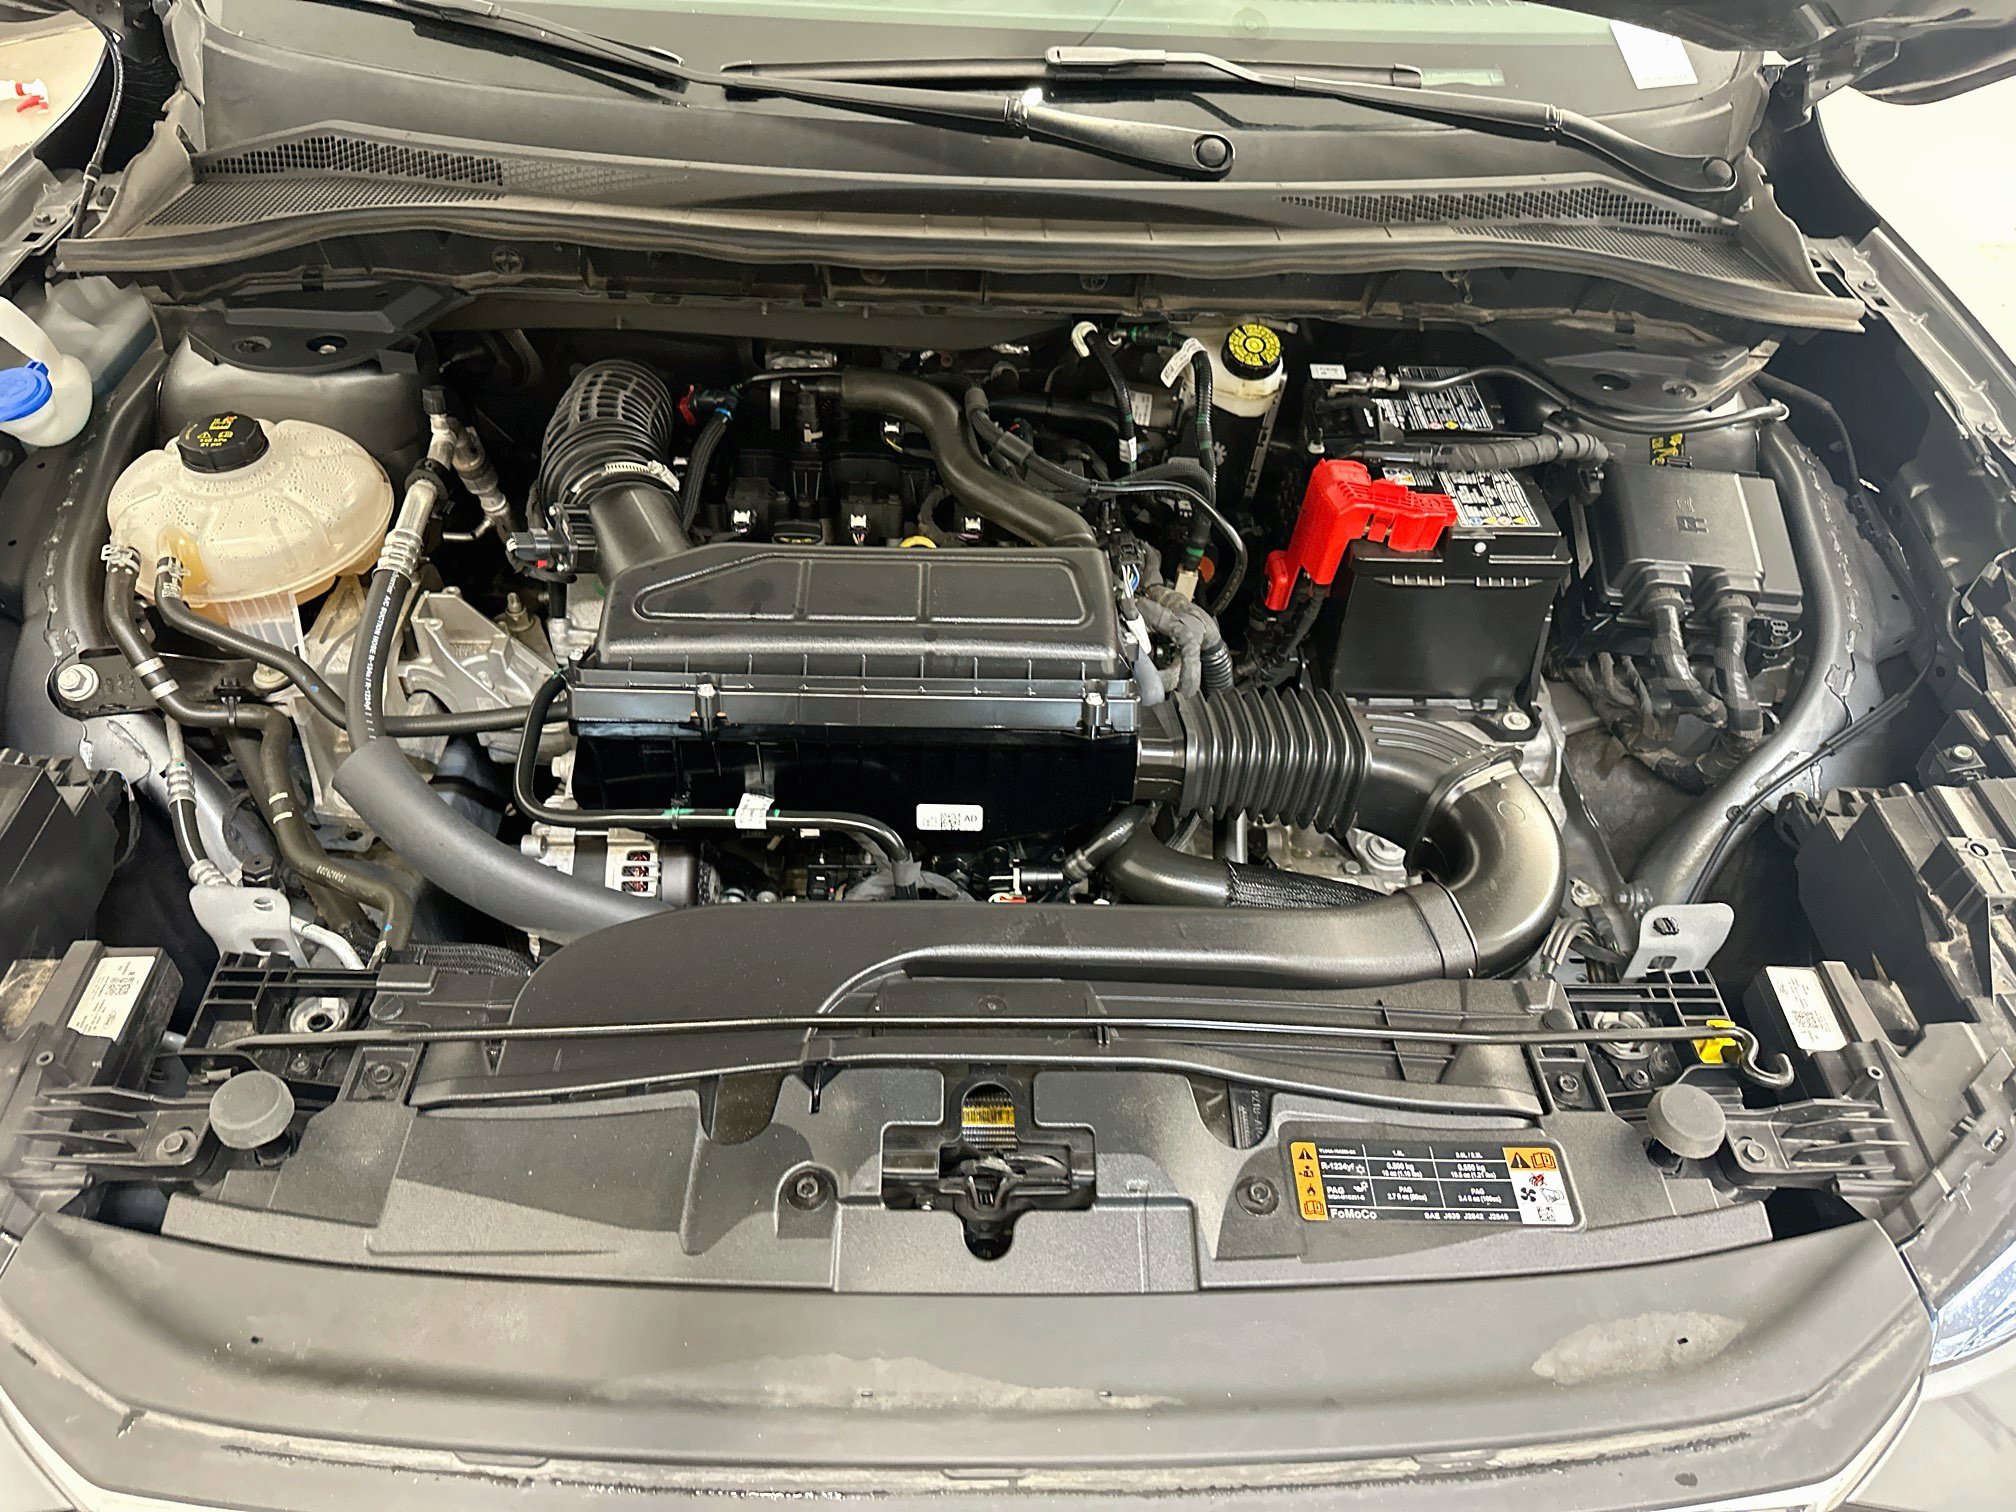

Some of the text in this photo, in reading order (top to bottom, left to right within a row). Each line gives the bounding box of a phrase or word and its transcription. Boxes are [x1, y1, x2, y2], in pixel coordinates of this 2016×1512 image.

[382, 594, 391, 607] A/C
[374, 606, 388, 636] SUCTION
[369, 635, 380, 655] HOSE
[365, 654, 375, 678] R-134a
[364, 681, 372, 711] R-1234yf
[1321, 1161, 1355, 1173] R-1234yf
[1404, 1162, 1415, 1173] kg
[1475, 1163, 1486, 1174] kg
[1326, 1186, 1345, 1195] PAG
[1398, 1185, 1413, 1193] PAG
[1470, 1187, 1485, 1195] PAG
[1330, 1208, 1377, 1220] FoMoCo
[1424, 1212, 1441, 1220] SAE
